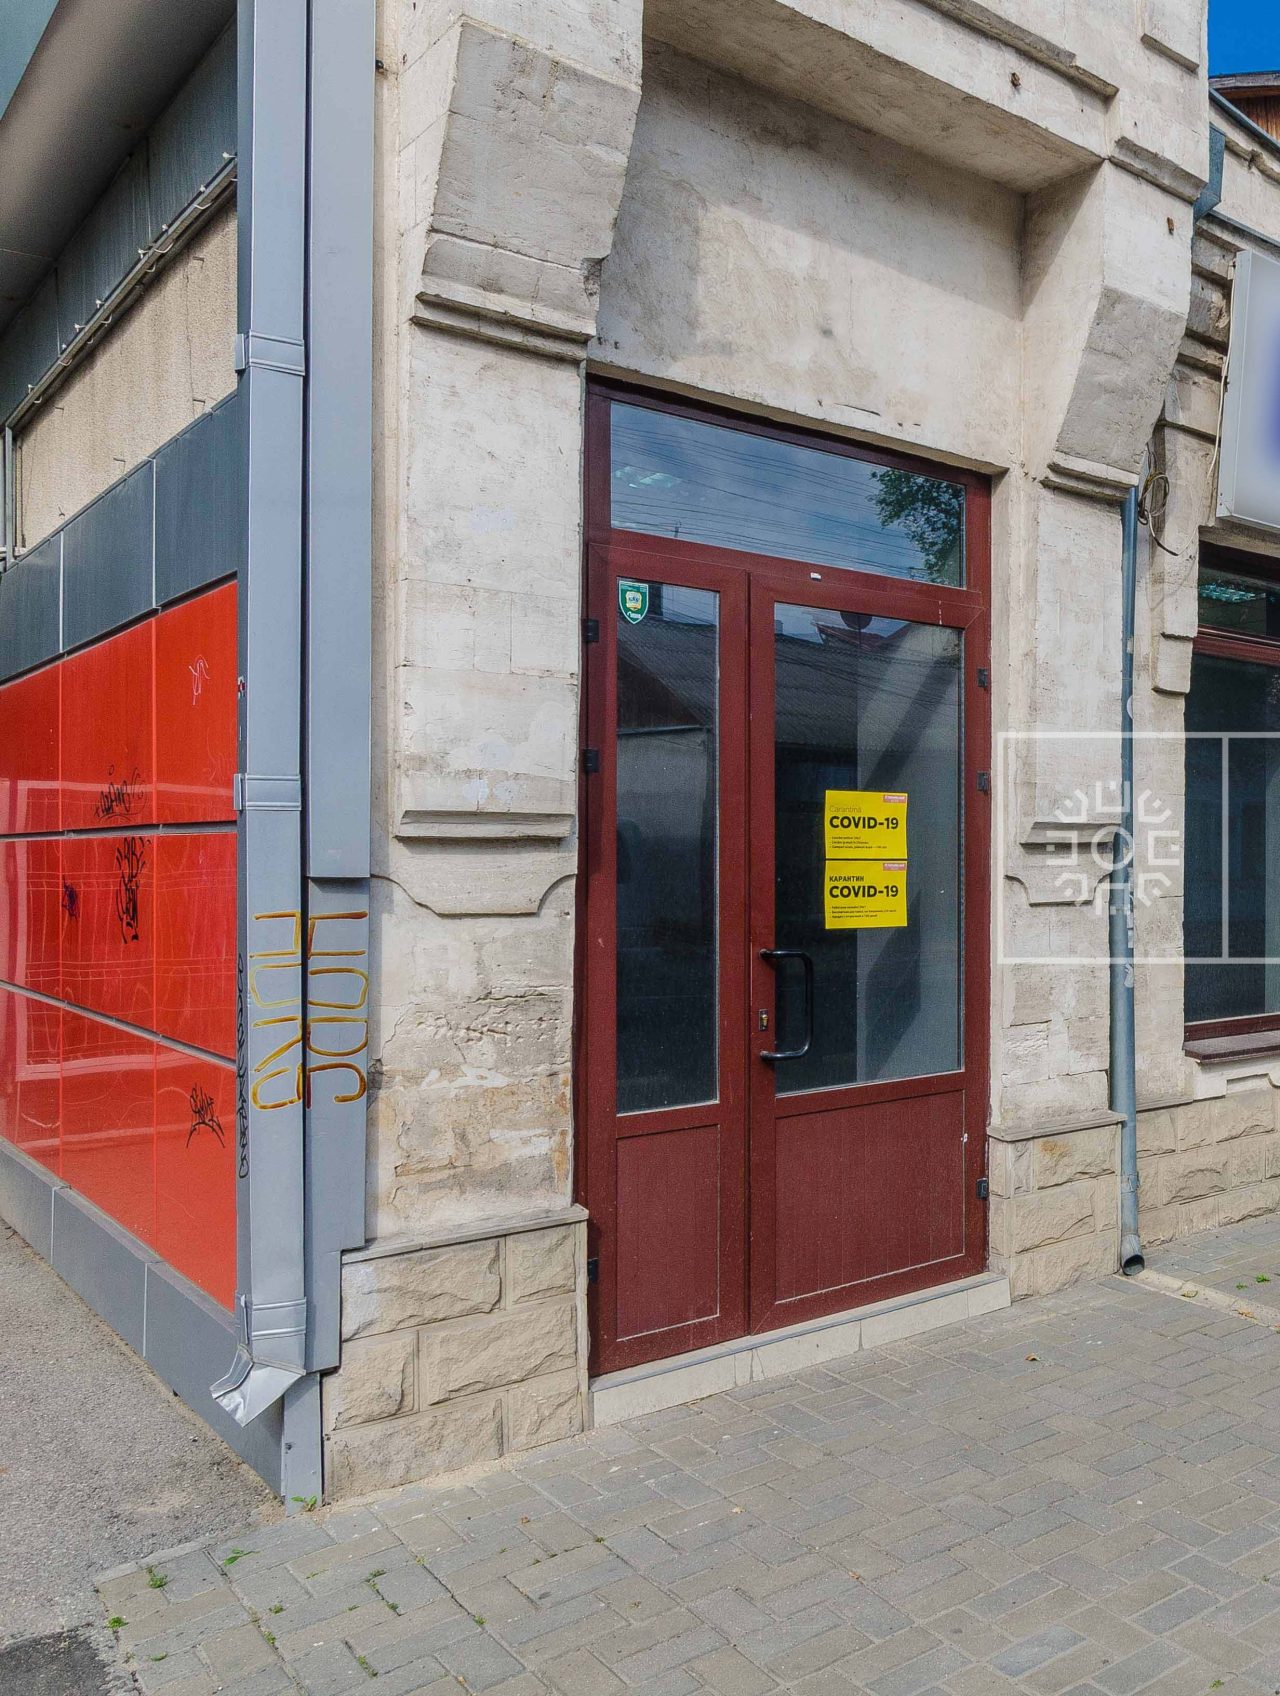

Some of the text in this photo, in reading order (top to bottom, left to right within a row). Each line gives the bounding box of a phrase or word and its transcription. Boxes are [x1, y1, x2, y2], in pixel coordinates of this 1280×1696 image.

[829, 815, 899, 830] COVID-19
[829, 875, 865, 883] КАРАНТИН
[829, 885, 899, 899] COVID-19
